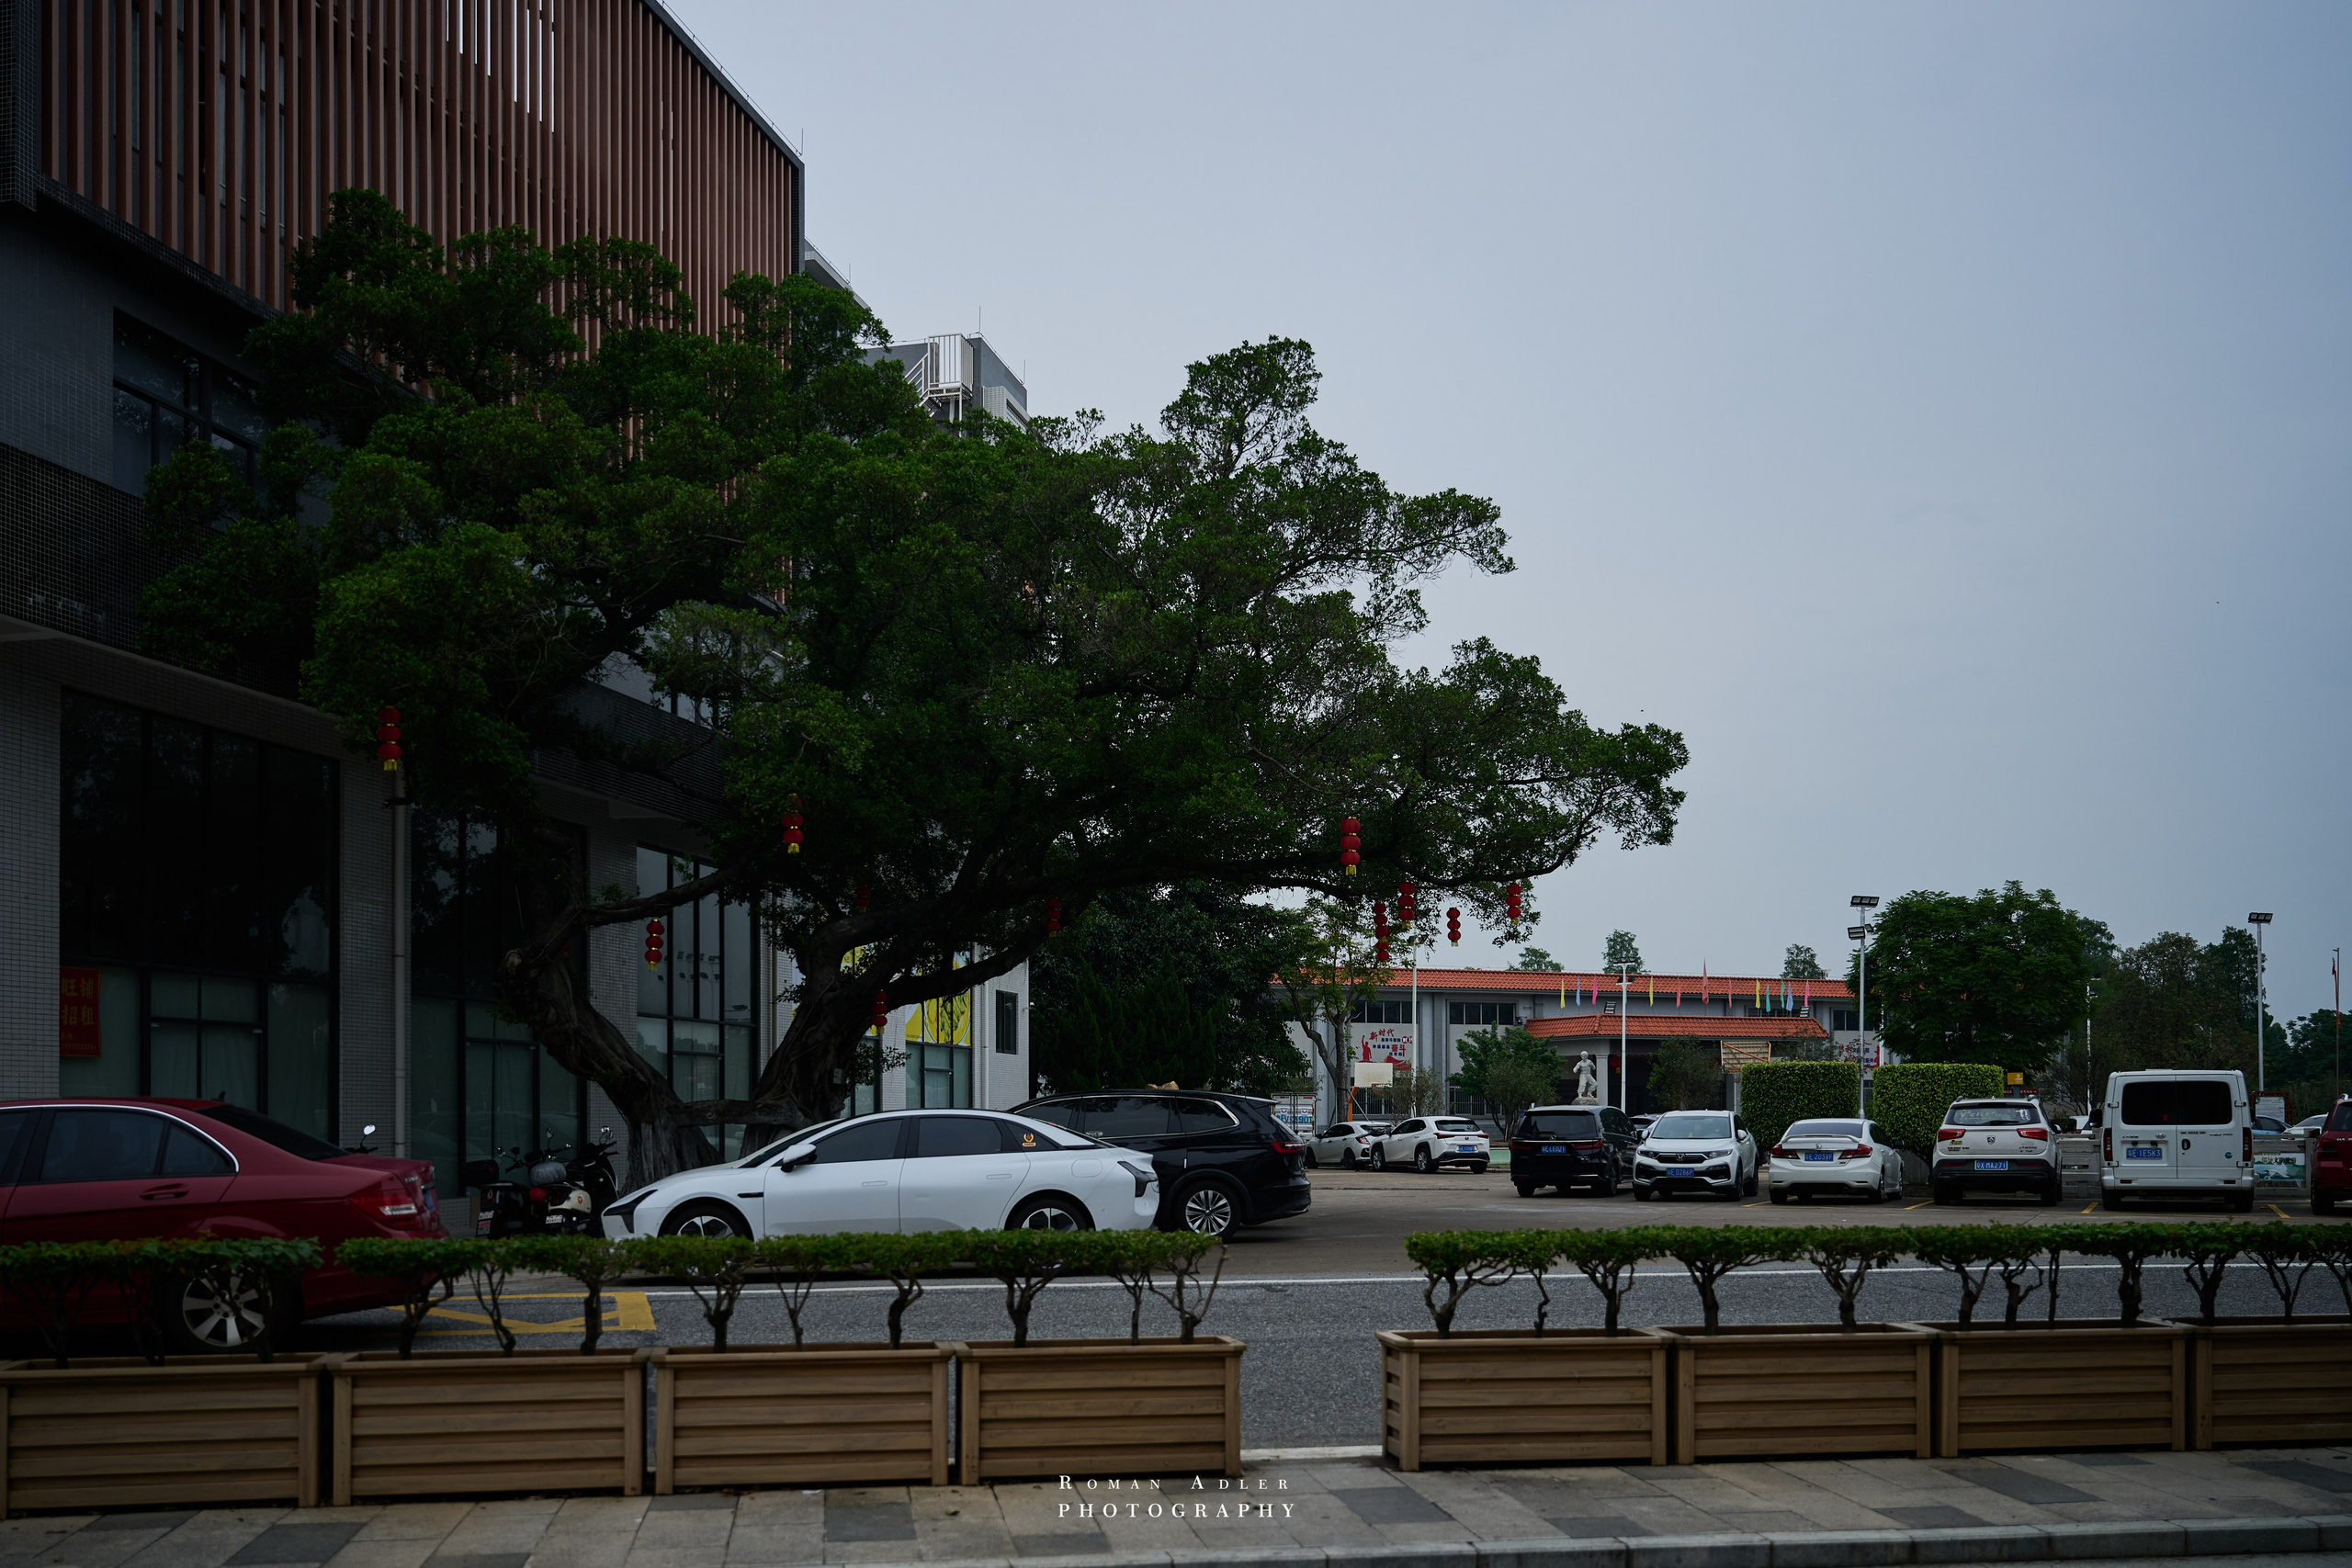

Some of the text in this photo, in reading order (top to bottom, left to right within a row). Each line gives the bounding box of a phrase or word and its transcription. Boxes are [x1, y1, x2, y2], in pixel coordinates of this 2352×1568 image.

[61, 976, 96, 1000] 旺铺
[61, 1003, 96, 1027] 招租
[1369, 1028, 1395, 1042] 新时代
